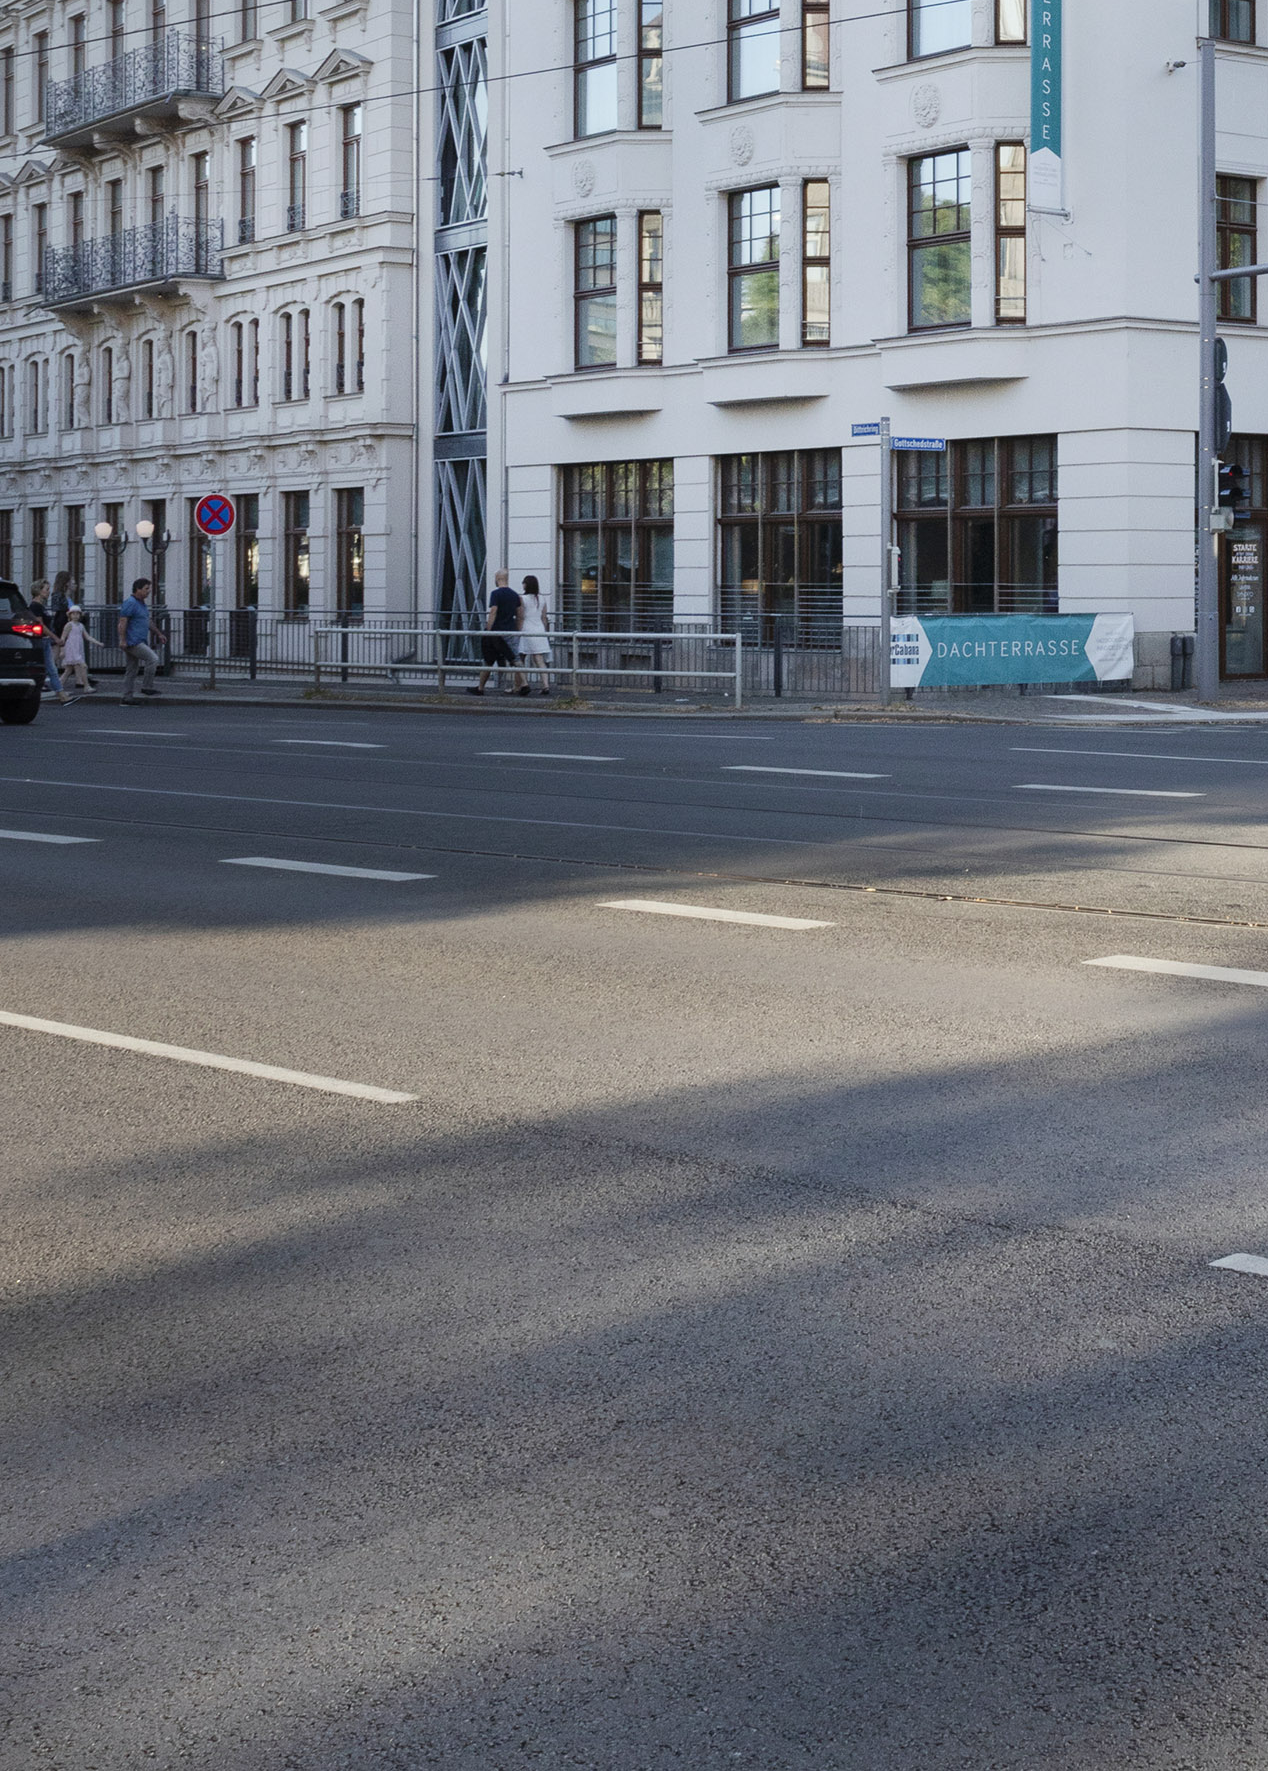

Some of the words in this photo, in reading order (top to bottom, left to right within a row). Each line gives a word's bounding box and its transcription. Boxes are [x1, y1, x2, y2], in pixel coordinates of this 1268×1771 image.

[893, 438, 943, 449] Gottschedstraße
[890, 644, 920, 656] rCabana
[938, 640, 1080, 658] DACHTERRASSE
